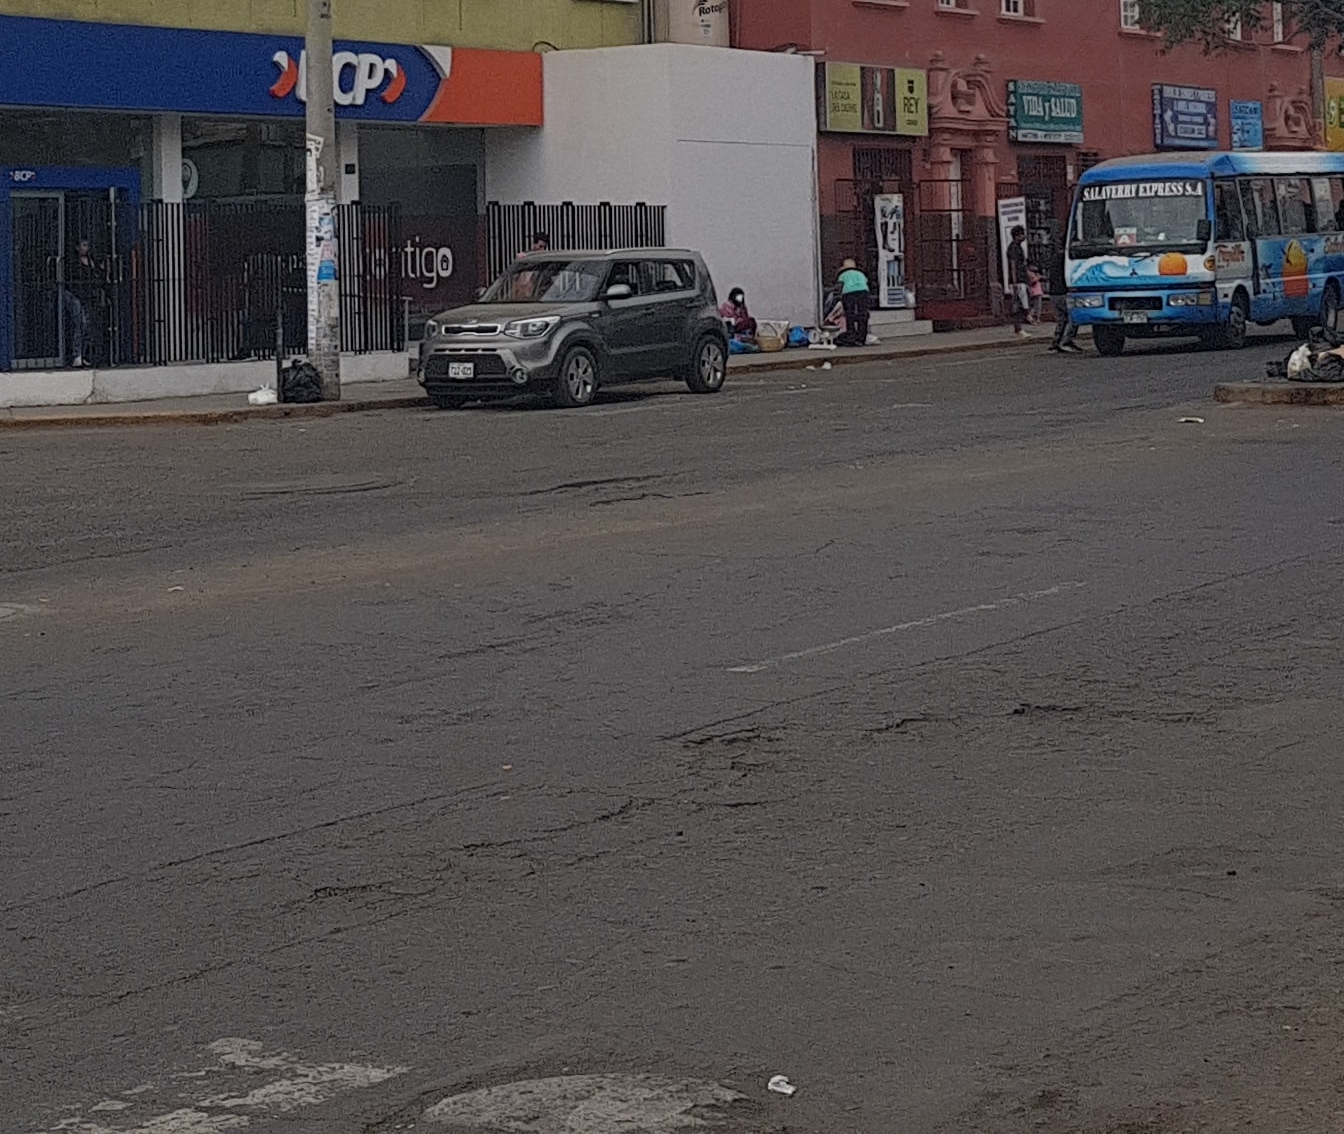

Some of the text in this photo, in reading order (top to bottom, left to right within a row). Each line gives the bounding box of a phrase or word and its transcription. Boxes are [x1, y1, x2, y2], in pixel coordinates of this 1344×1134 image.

[903, 97, 920, 114] REY
[1022, 95, 1044, 116] VIDA
[1050, 97, 1076, 118] SALUD
[15, 170, 32, 182] BCP
[1083, 184, 1136, 201] SALAVERRY
[1138, 182, 1183, 197] EXPRESS
